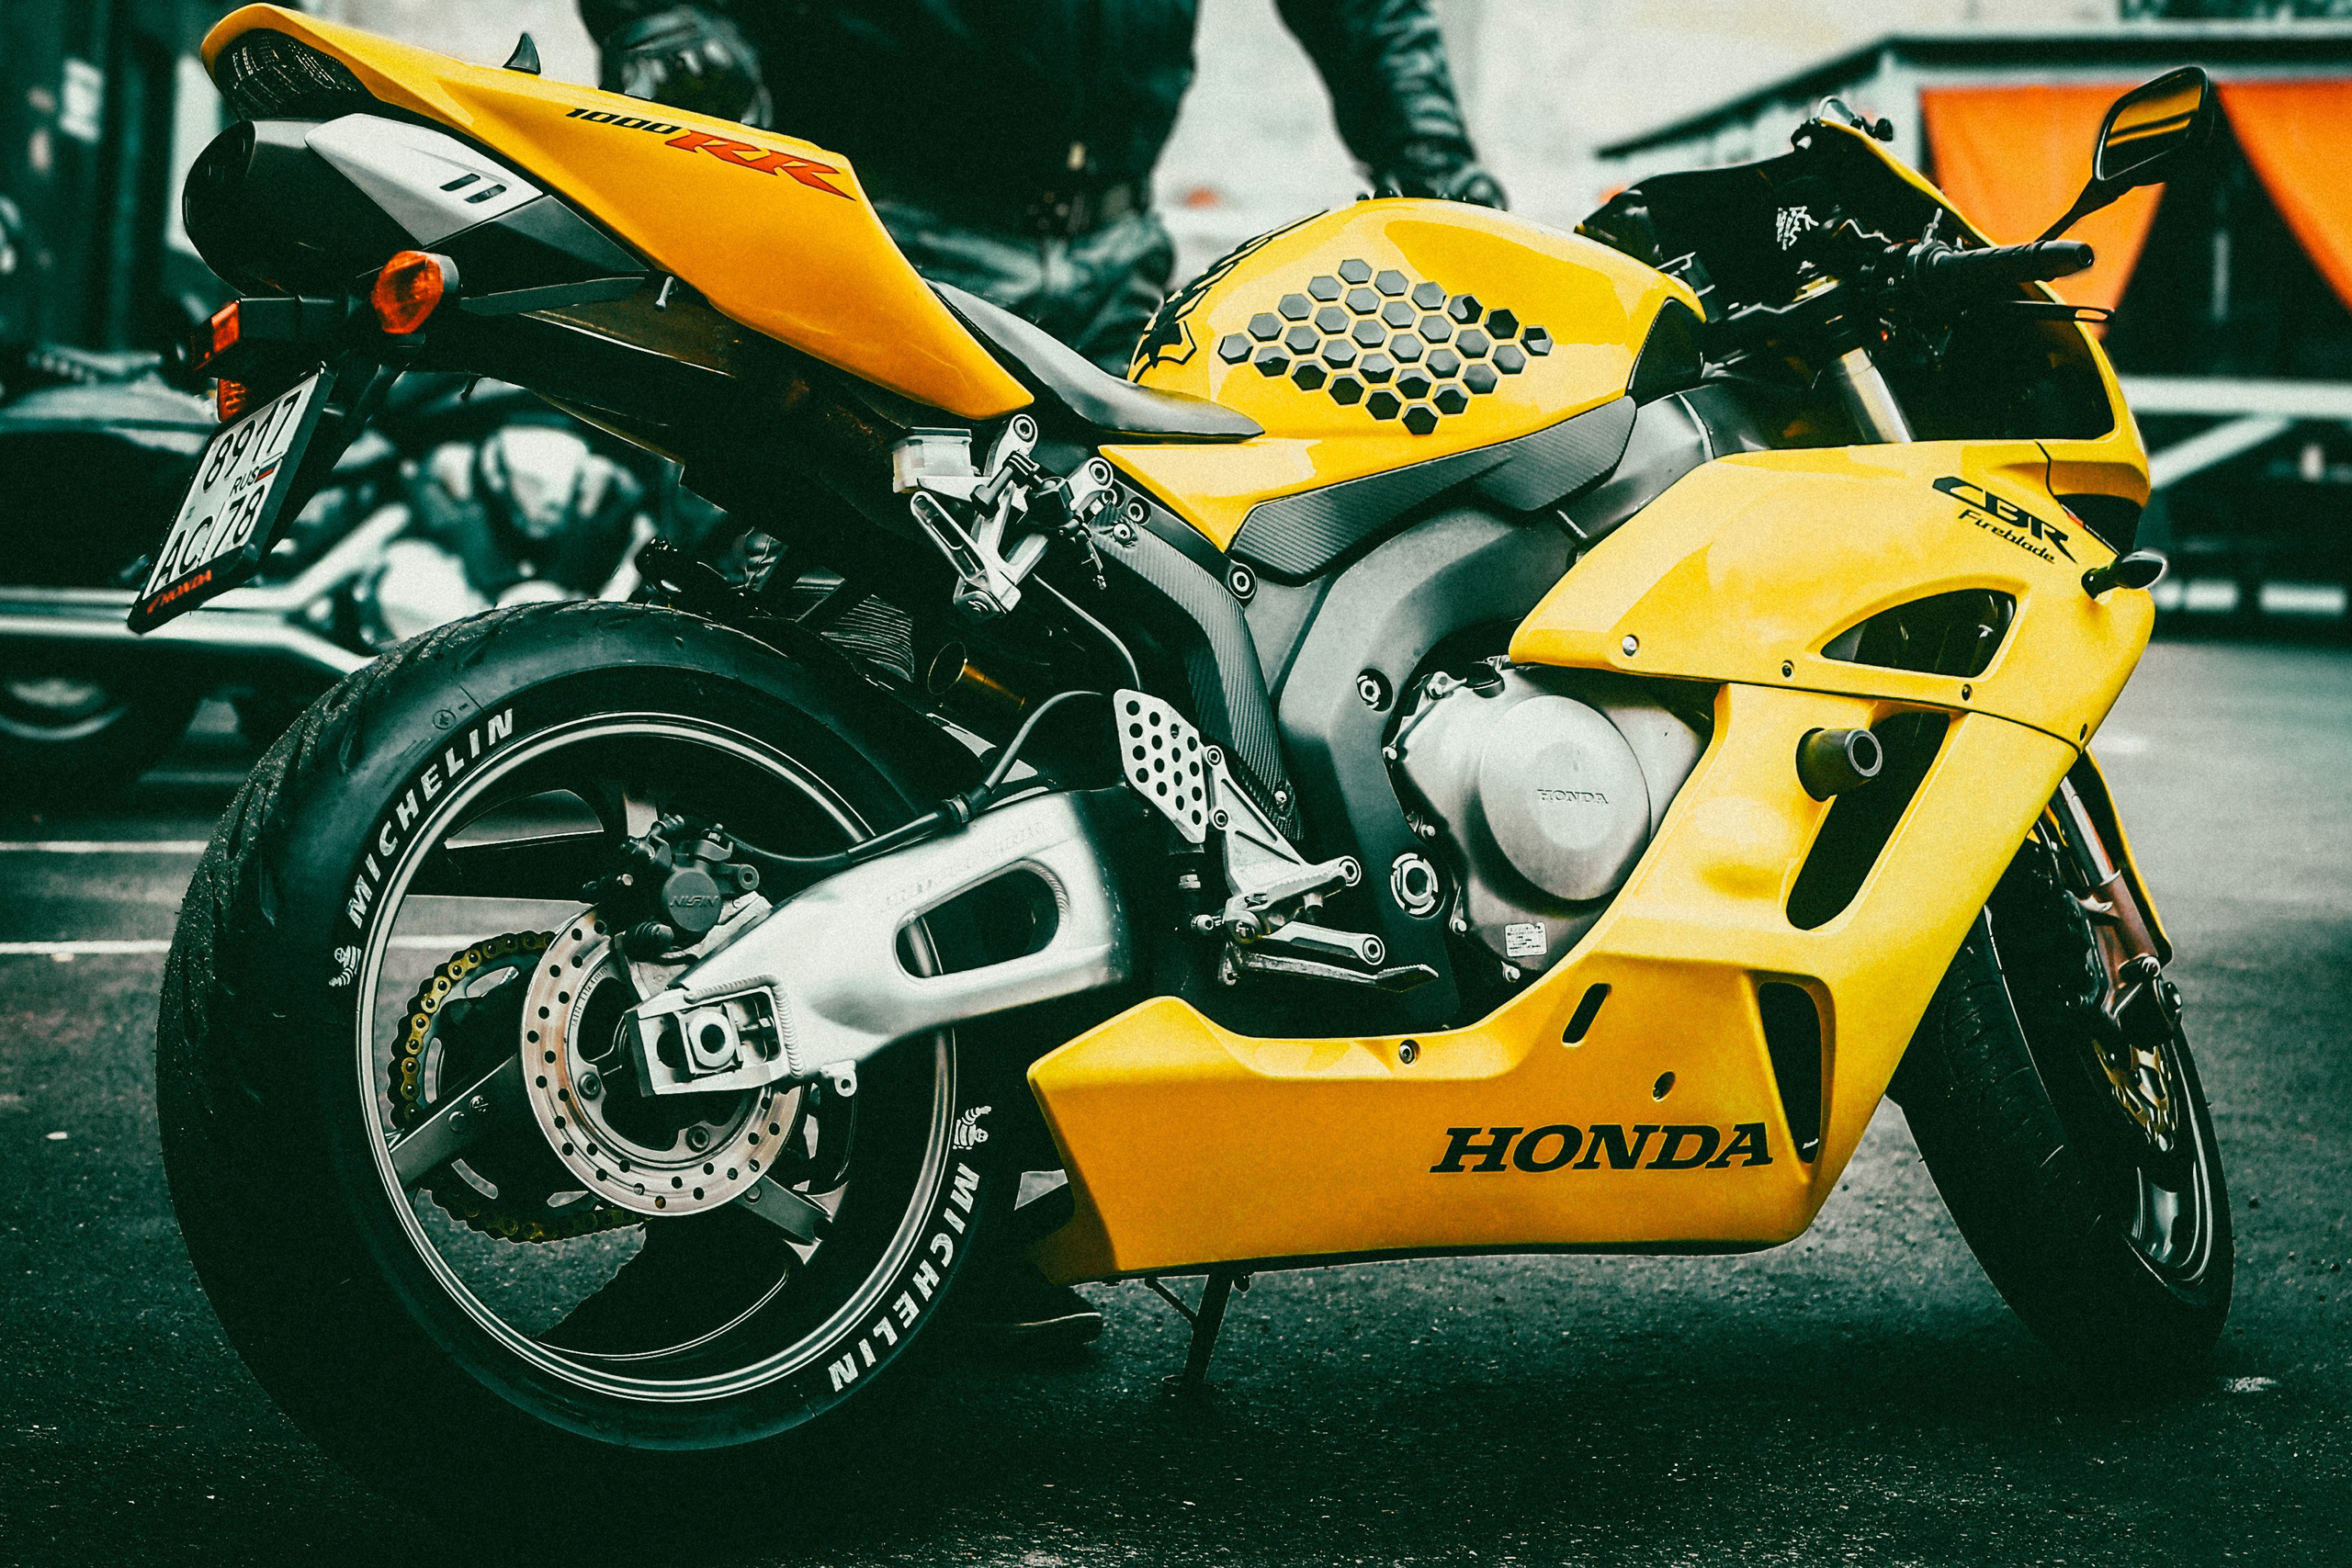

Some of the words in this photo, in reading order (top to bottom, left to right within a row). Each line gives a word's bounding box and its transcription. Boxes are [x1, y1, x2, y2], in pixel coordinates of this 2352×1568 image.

[202, 389, 302, 493] 8917
[230, 465, 260, 497] RUS
[150, 515, 214, 592] AC
[211, 484, 266, 558] 78
[1932, 476, 2078, 565] CBR
[1958, 508, 2055, 564] Fireblade
[160, 569, 212, 607] HONDA
[345, 708, 514, 930] MICHELIN
[1536, 788, 1610, 805] HONDA
[1429, 1122, 1774, 1174] HONDA
[828, 1162, 981, 1393] MICHELIN
